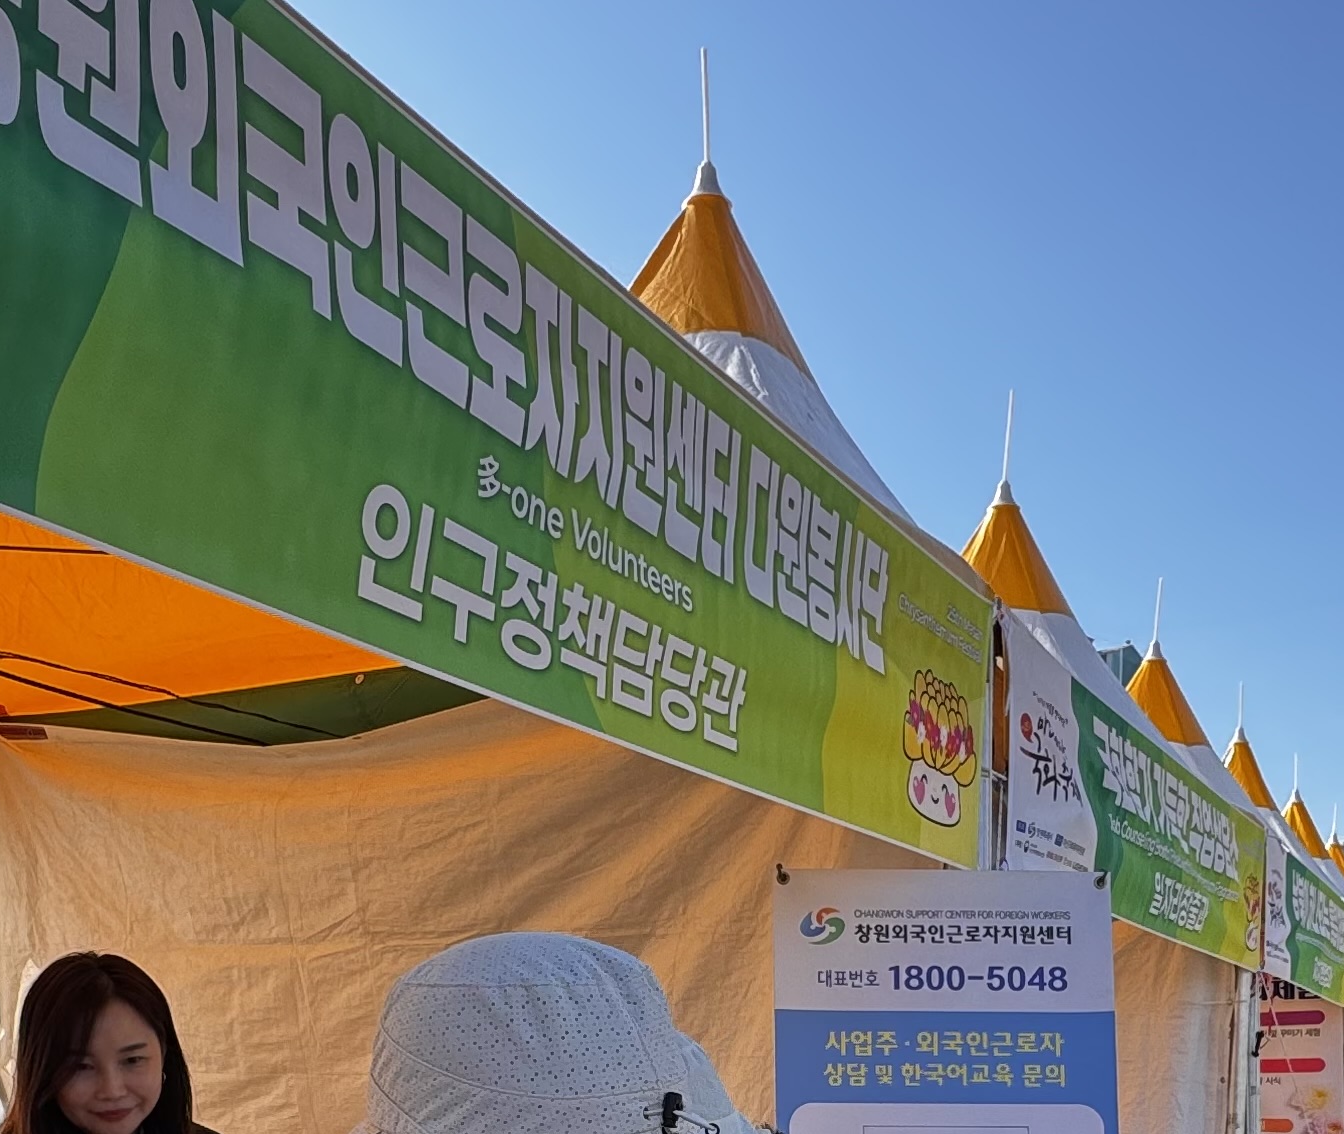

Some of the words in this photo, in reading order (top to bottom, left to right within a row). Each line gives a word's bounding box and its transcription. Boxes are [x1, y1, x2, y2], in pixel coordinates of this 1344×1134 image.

[570, 506, 695, 613] Volunteers
[744, 443, 891, 676] 다원봉사단
[357, 483, 747, 753] 인구정책담당관
[854, 909, 904, 919] CHANGWON
[905, 909, 943, 920] SUPPORT
[945, 910, 976, 920] CENTER
[977, 911, 994, 920] FOR
[995, 911, 1030, 920] FOREIGN
[1030, 911, 1071, 921] WORKERS
[854, 923, 1072, 945] 창원외국인근로자지원센터
[817, 969, 880, 988] 대표번호
[888, 965, 1068, 992] 1800-5048
[916, 1031, 1065, 1057] 외국인근로자
[824, 1063, 869, 1088] 상담
[874, 1065, 894, 1085] 및
[901, 1063, 1014, 1088] 한국어교육
[1021, 1065, 1067, 1088] 문의
